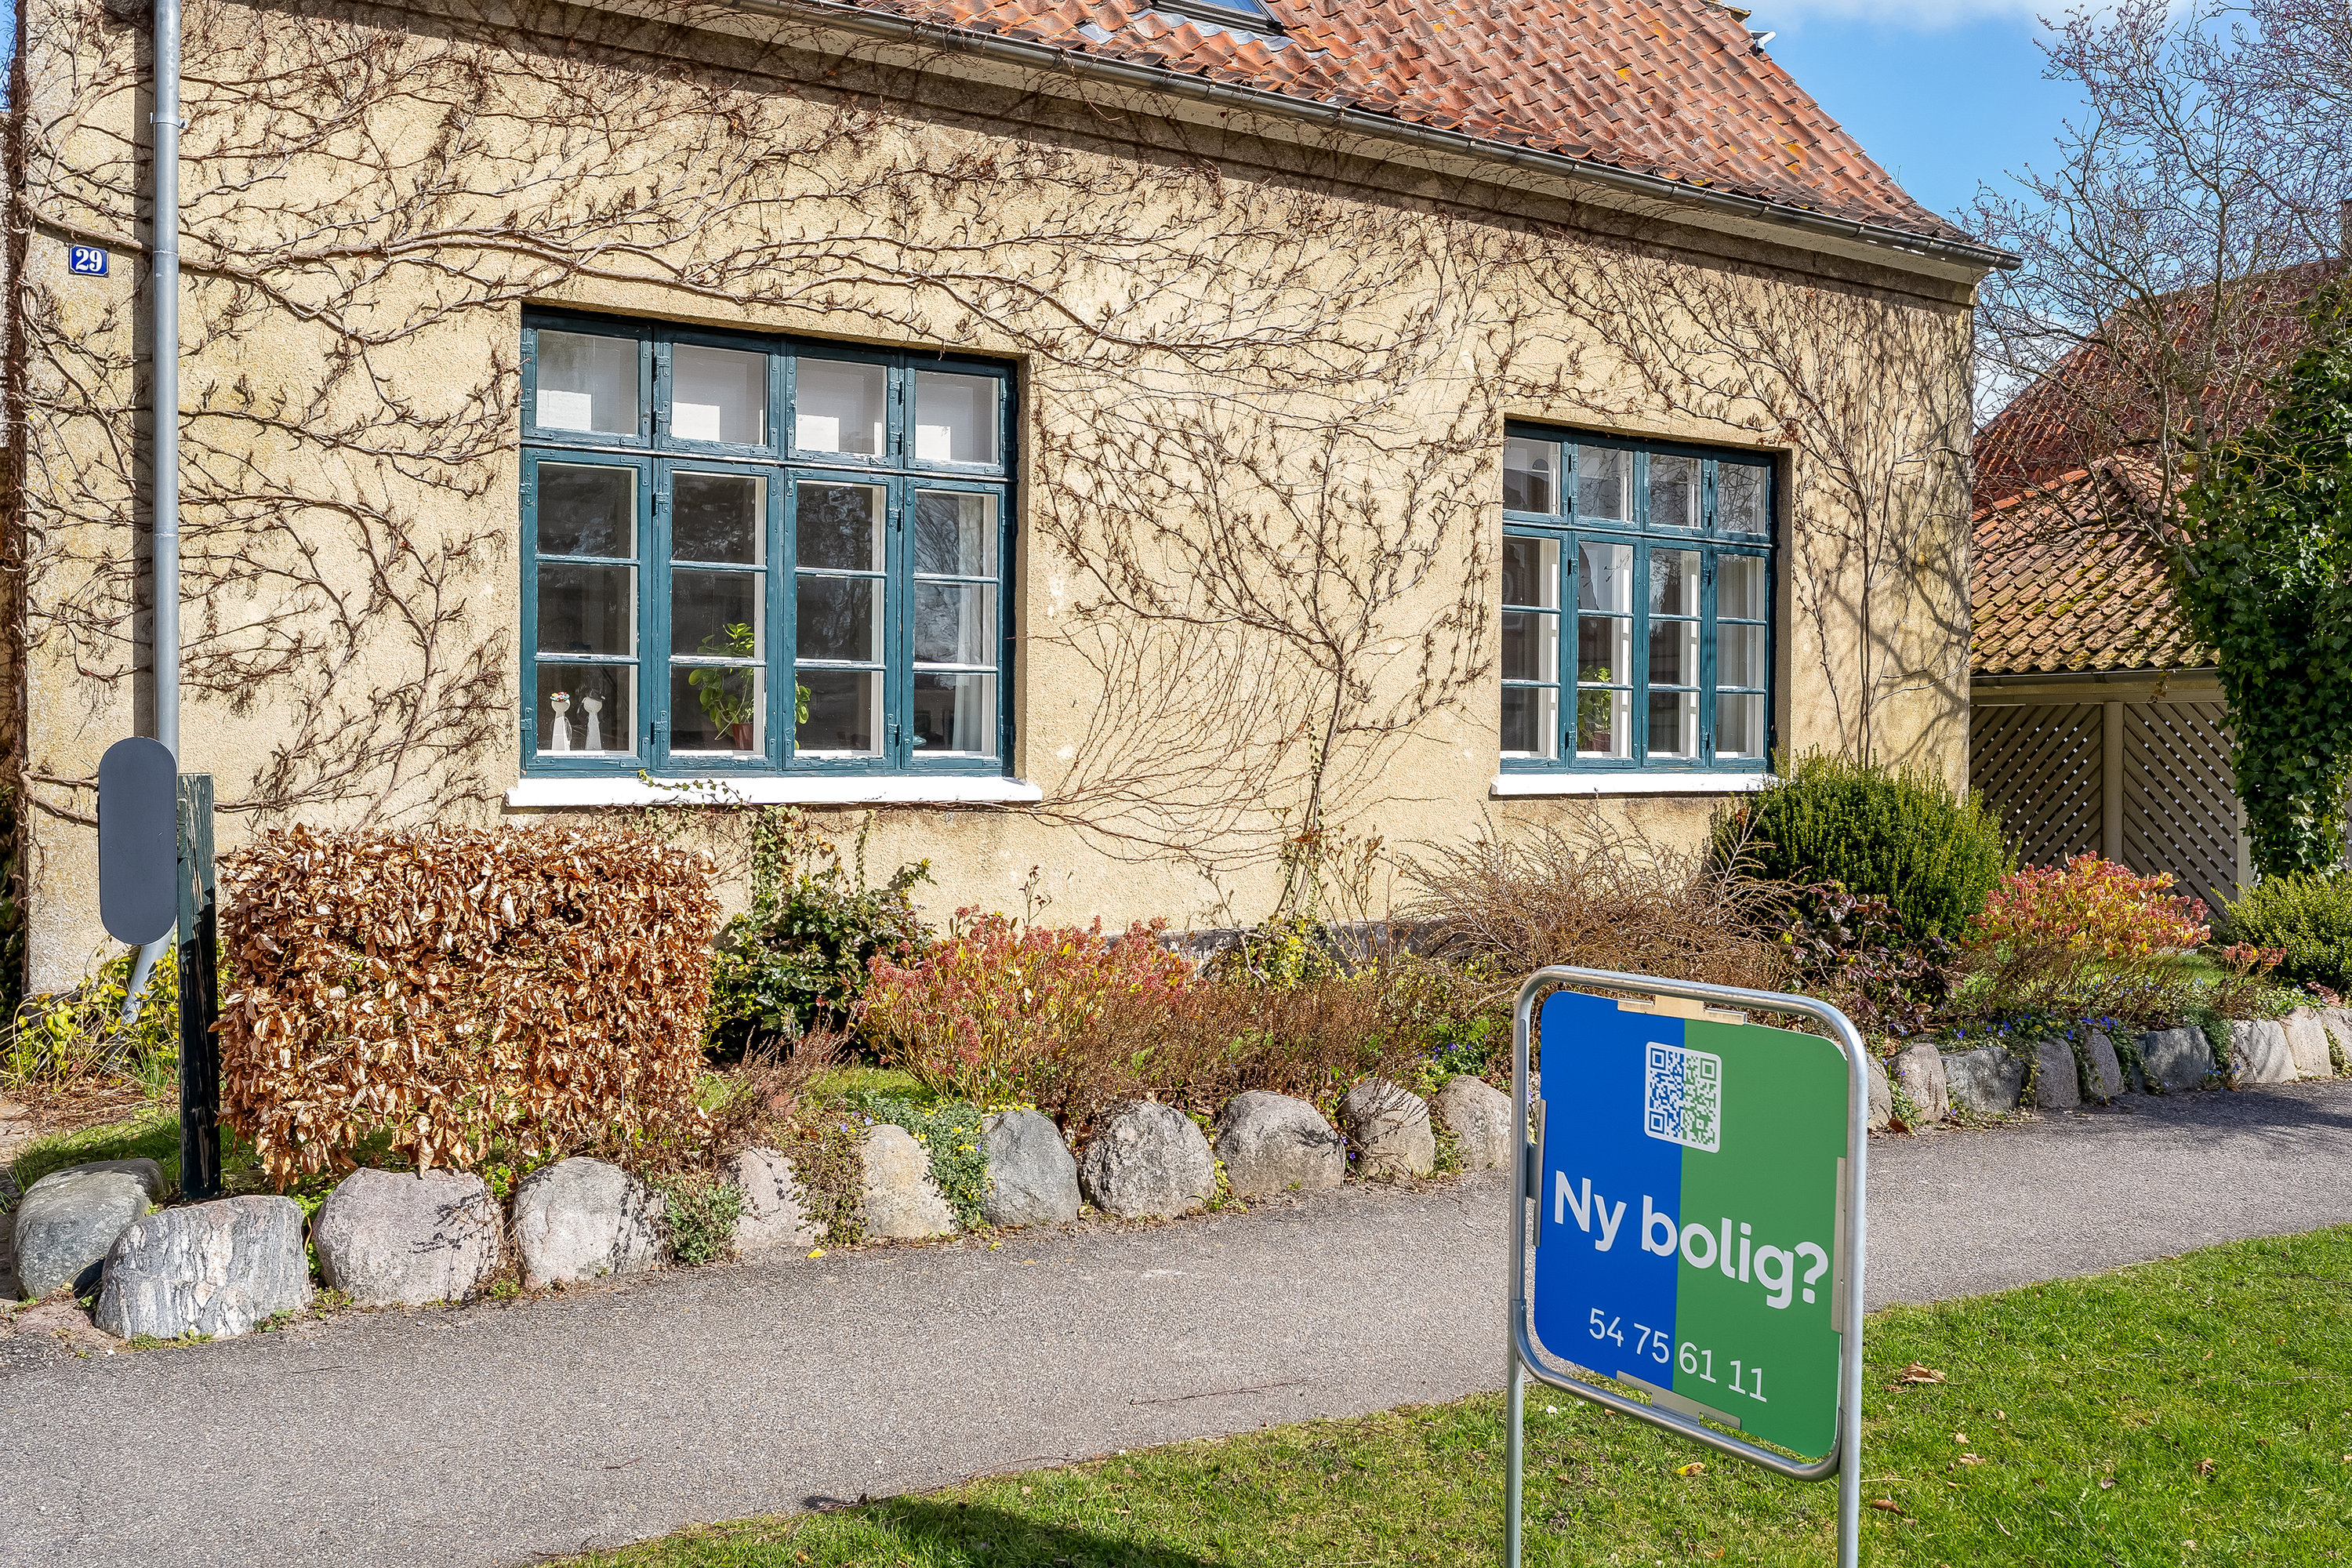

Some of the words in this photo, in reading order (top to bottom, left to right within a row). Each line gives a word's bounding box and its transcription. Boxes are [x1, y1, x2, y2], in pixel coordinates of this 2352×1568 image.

[75, 249, 103, 272] 29
[1554, 1170, 1627, 1252] Ny
[1641, 1195, 1829, 1309] bolig?
[1589, 1308, 1624, 1347] 54
[1634, 1322, 1669, 1363] 75
[1679, 1341, 1716, 1384] 61
[1728, 1360, 1768, 1403] 11
